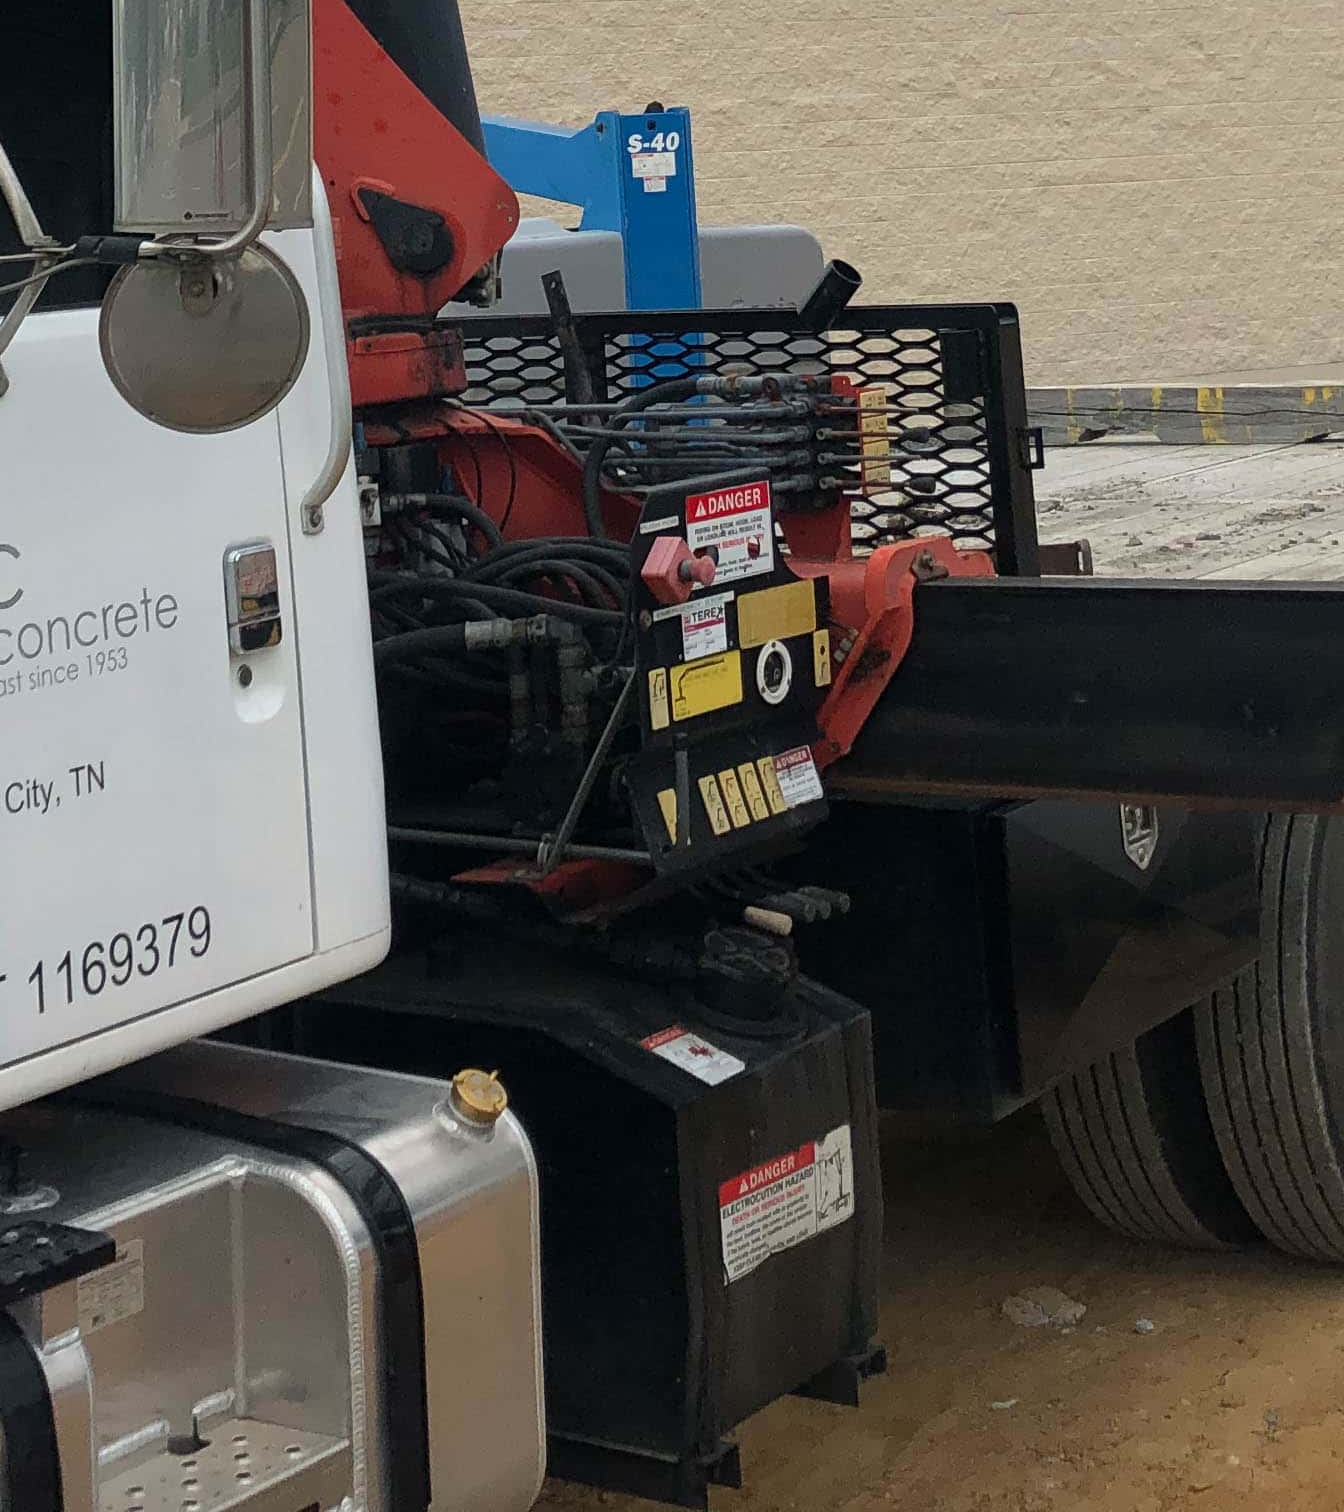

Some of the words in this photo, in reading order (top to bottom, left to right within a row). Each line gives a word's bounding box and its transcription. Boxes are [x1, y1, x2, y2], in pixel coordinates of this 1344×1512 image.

[626, 131, 681, 154] S-40
[708, 487, 762, 515] DANGER
[28, 660, 79, 691] since
[85, 646, 129, 677] 1953
[4, 778, 62, 815] City,
[68, 760, 105, 798] TN
[28, 905, 212, 1015] 1169379
[749, 1155, 795, 1189] DANGER
